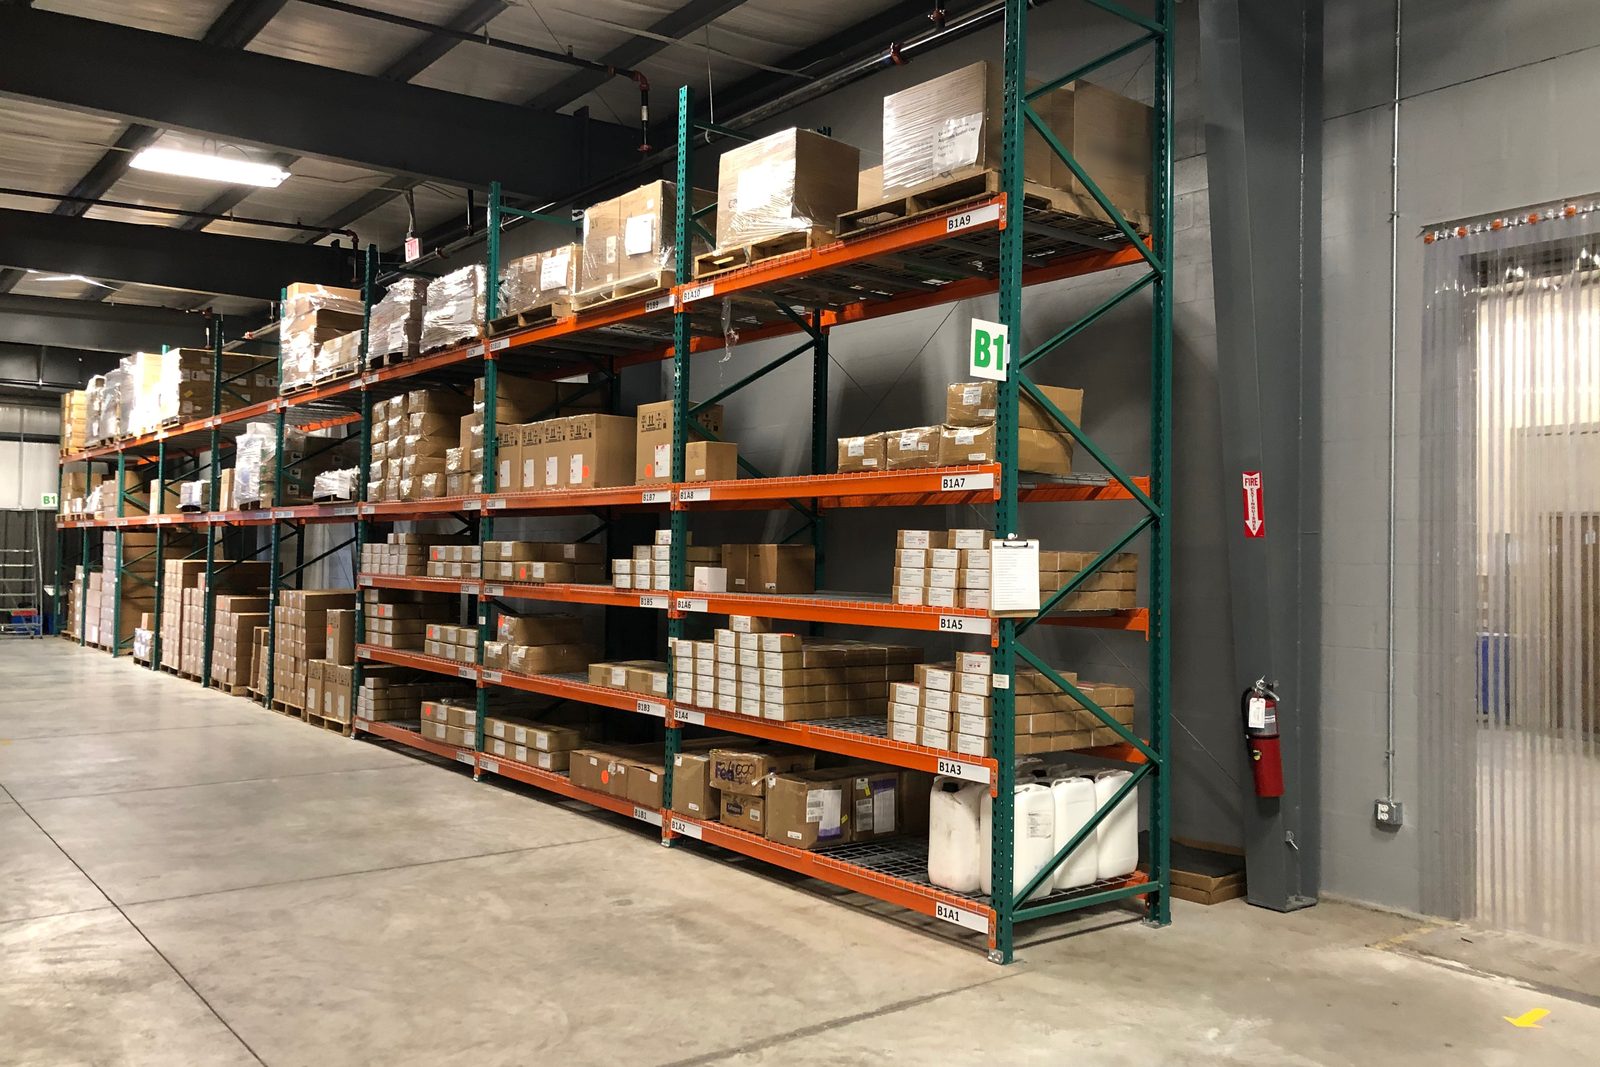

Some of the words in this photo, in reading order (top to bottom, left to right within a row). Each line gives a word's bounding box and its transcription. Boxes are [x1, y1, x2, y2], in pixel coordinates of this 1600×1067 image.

[949, 215, 970, 229] B1A9
[683, 290, 701, 301] B1A10
[974, 329, 1004, 371] B1
[943, 478, 965, 488] B1A7
[1245, 478, 1258, 486] FIRE
[43, 495, 56, 505] B1
[643, 493, 656, 501] B1B7
[680, 491, 694, 500] B1A8
[640, 597, 653, 606] B1B5
[677, 600, 692, 609] B1A6
[941, 619, 963, 629] B1A5
[637, 702, 650, 712] B1B3
[674, 710, 689, 720] B1A4
[940, 762, 961, 775] B1A3
[634, 808, 647, 819] B1B1
[671, 820, 686, 832] B1A2
[937, 906, 959, 921] B1A1
